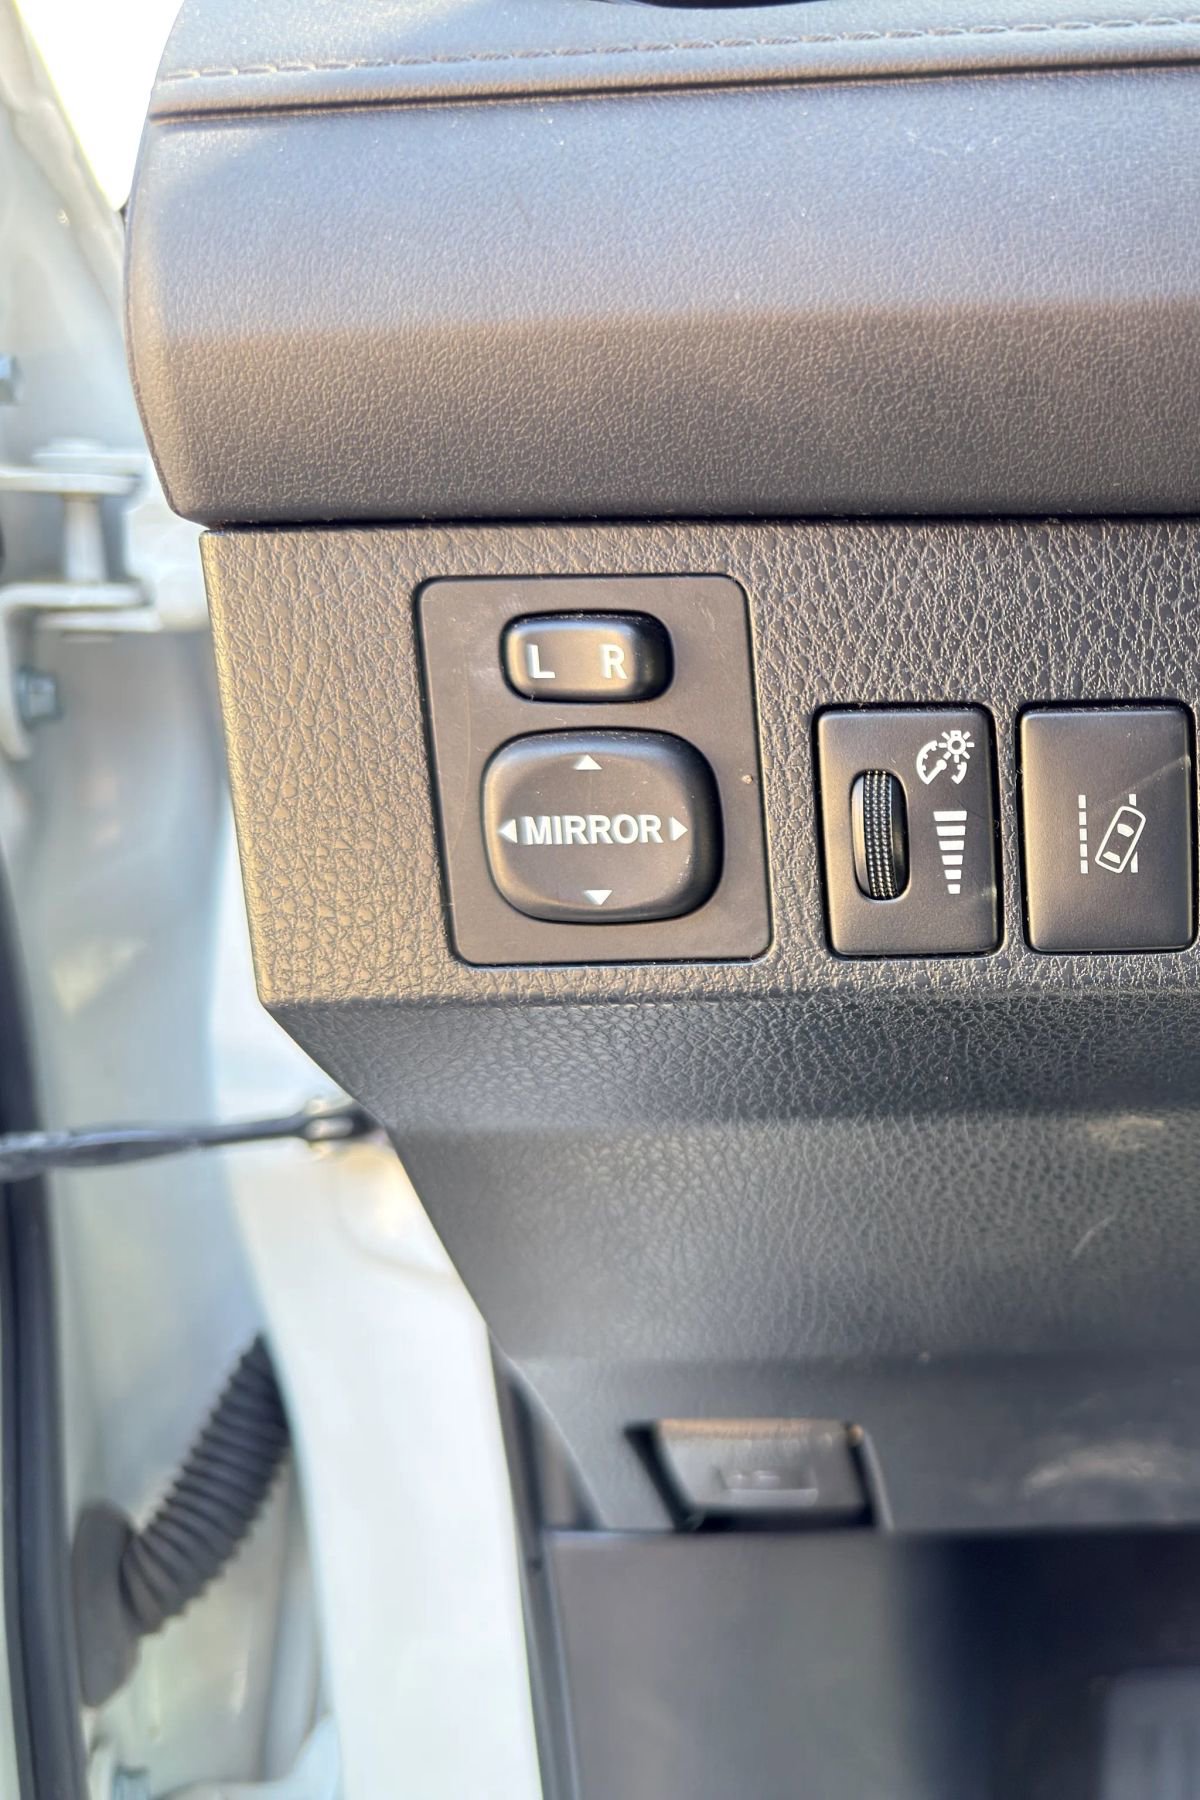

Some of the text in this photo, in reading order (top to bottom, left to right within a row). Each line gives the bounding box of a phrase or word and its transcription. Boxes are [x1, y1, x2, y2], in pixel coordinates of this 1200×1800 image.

[528, 644, 628, 680] L R
[520, 813, 664, 846] MIRROR
